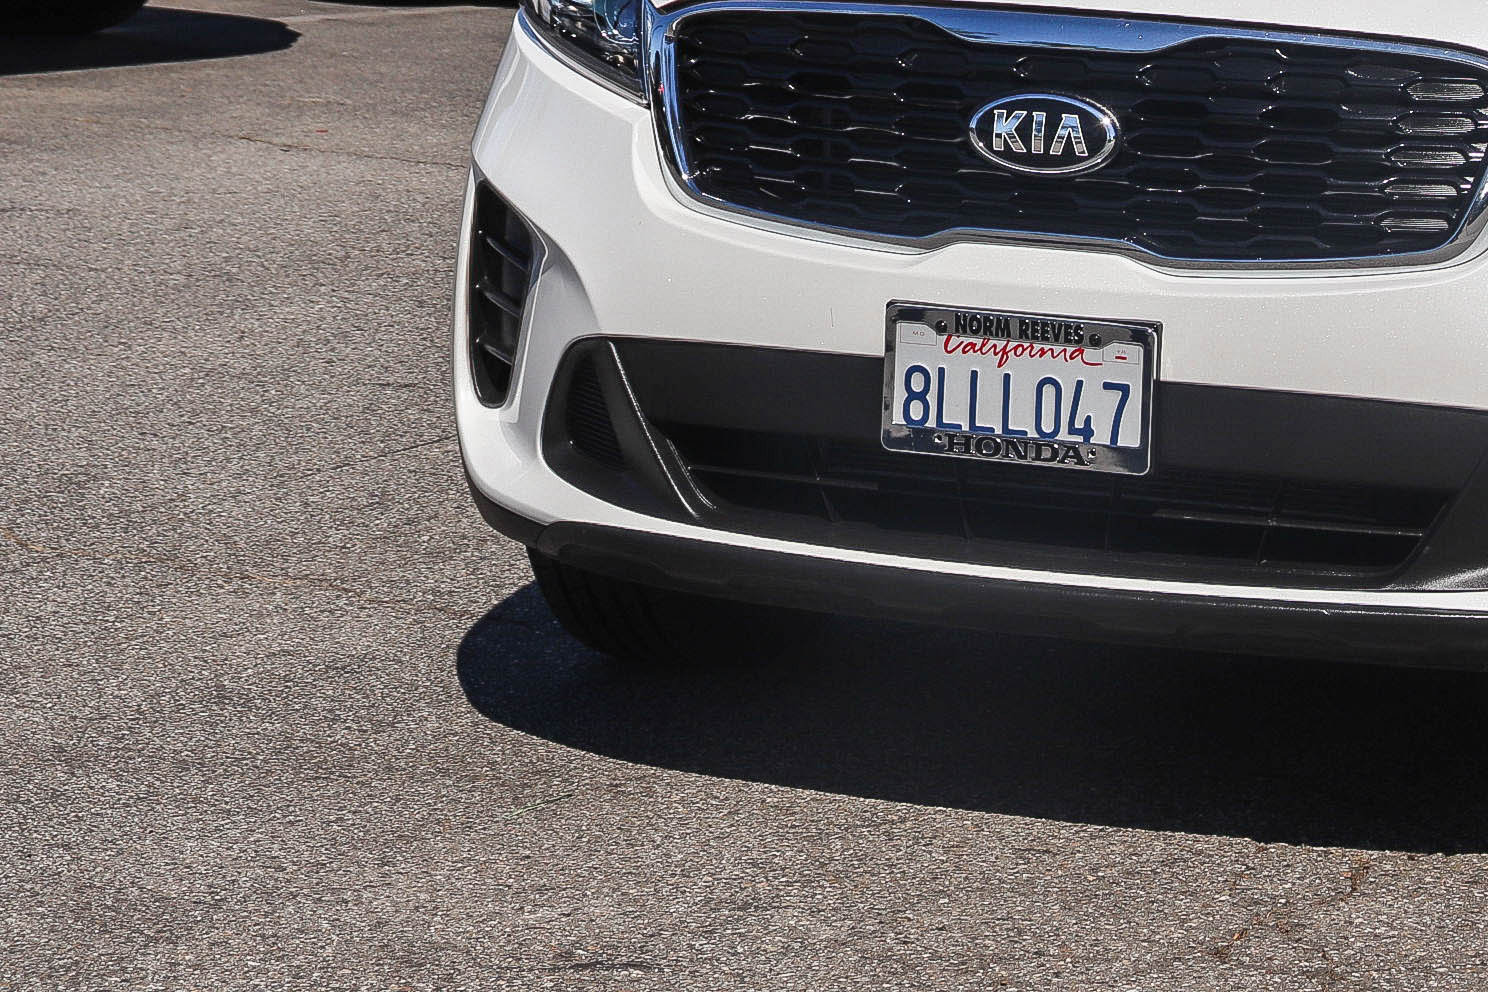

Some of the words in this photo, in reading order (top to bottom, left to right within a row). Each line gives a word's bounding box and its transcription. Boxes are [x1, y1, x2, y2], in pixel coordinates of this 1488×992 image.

[993, 109, 1089, 157] KIA
[954, 312, 1012, 338] NORM
[1018, 319, 1085, 345] REEVES
[943, 333, 1103, 369] California
[902, 364, 1132, 448] 8LLL047
[943, 433, 1094, 467] HONDA
